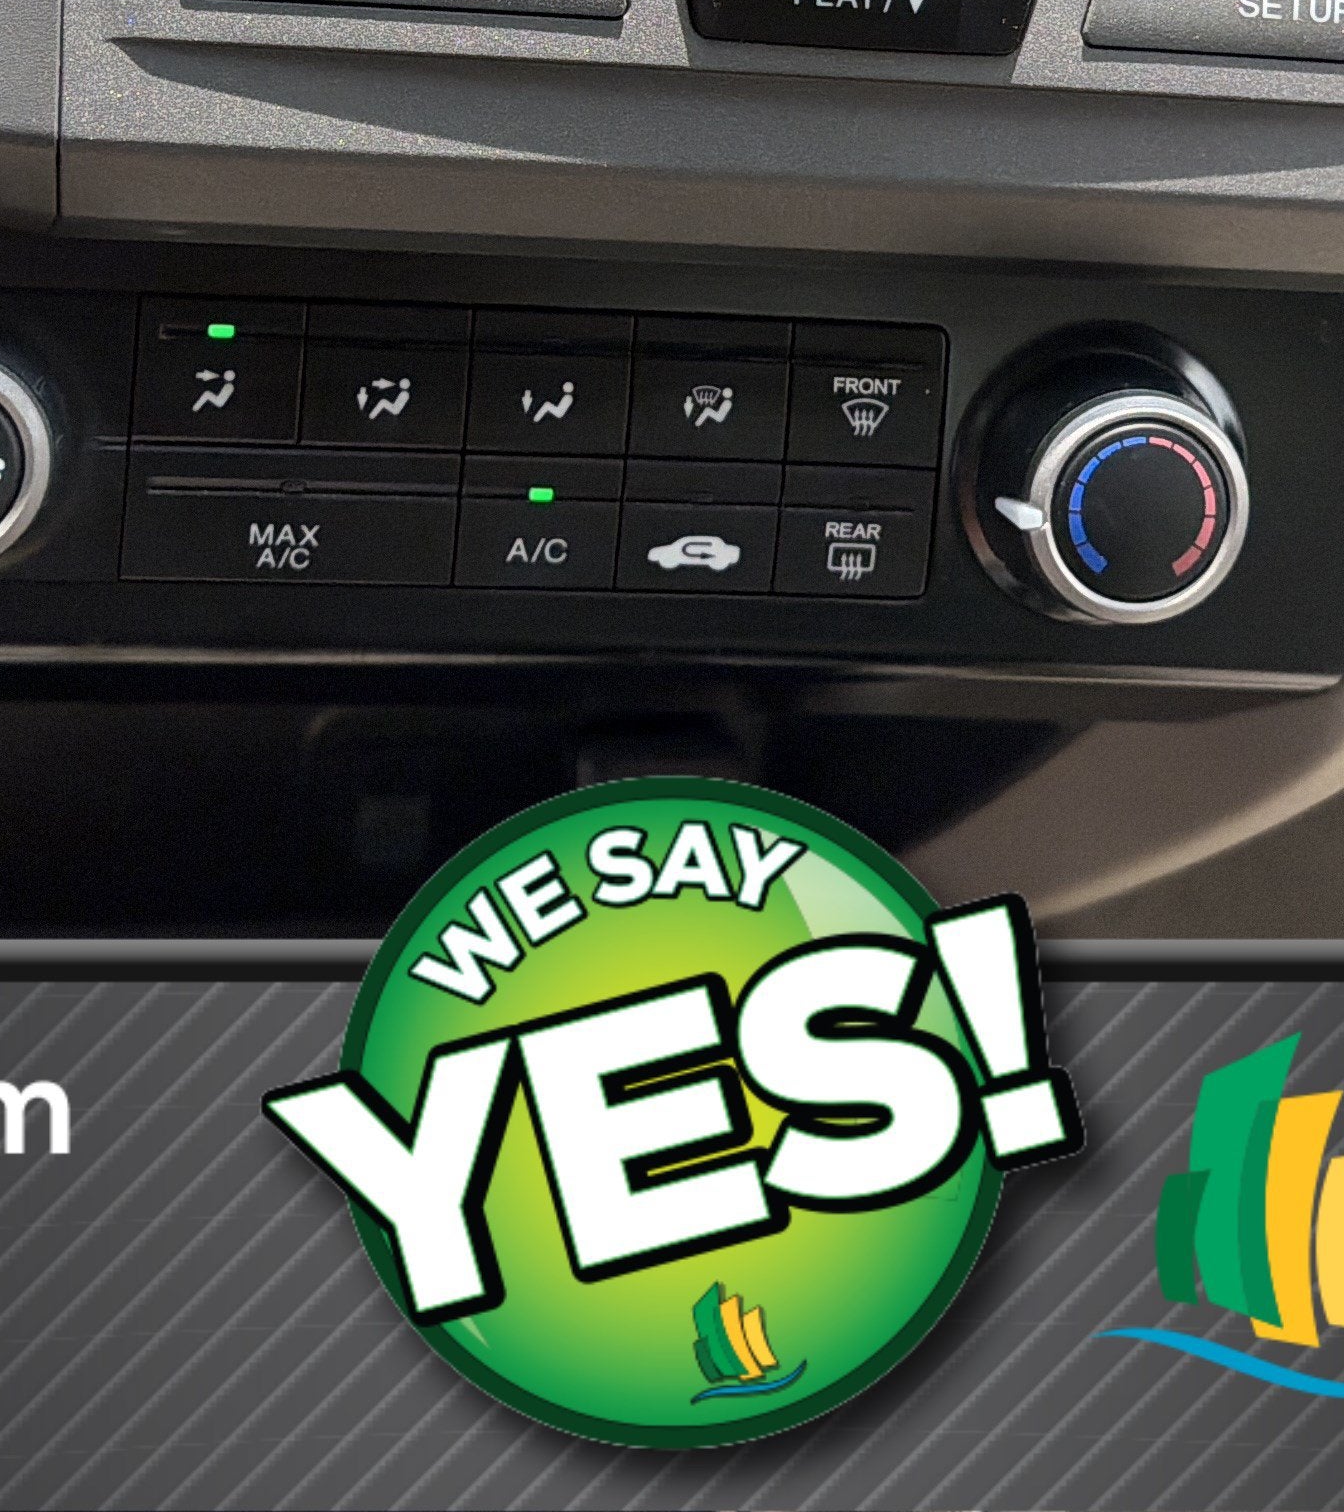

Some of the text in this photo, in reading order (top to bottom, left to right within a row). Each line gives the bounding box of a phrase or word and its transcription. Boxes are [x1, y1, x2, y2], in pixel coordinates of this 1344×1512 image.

[832, 375, 903, 396] FRONT
[248, 522, 321, 548] MAX
[823, 520, 883, 540] REAR
[255, 546, 311, 571] A/C
[505, 536, 569, 564] A/C
